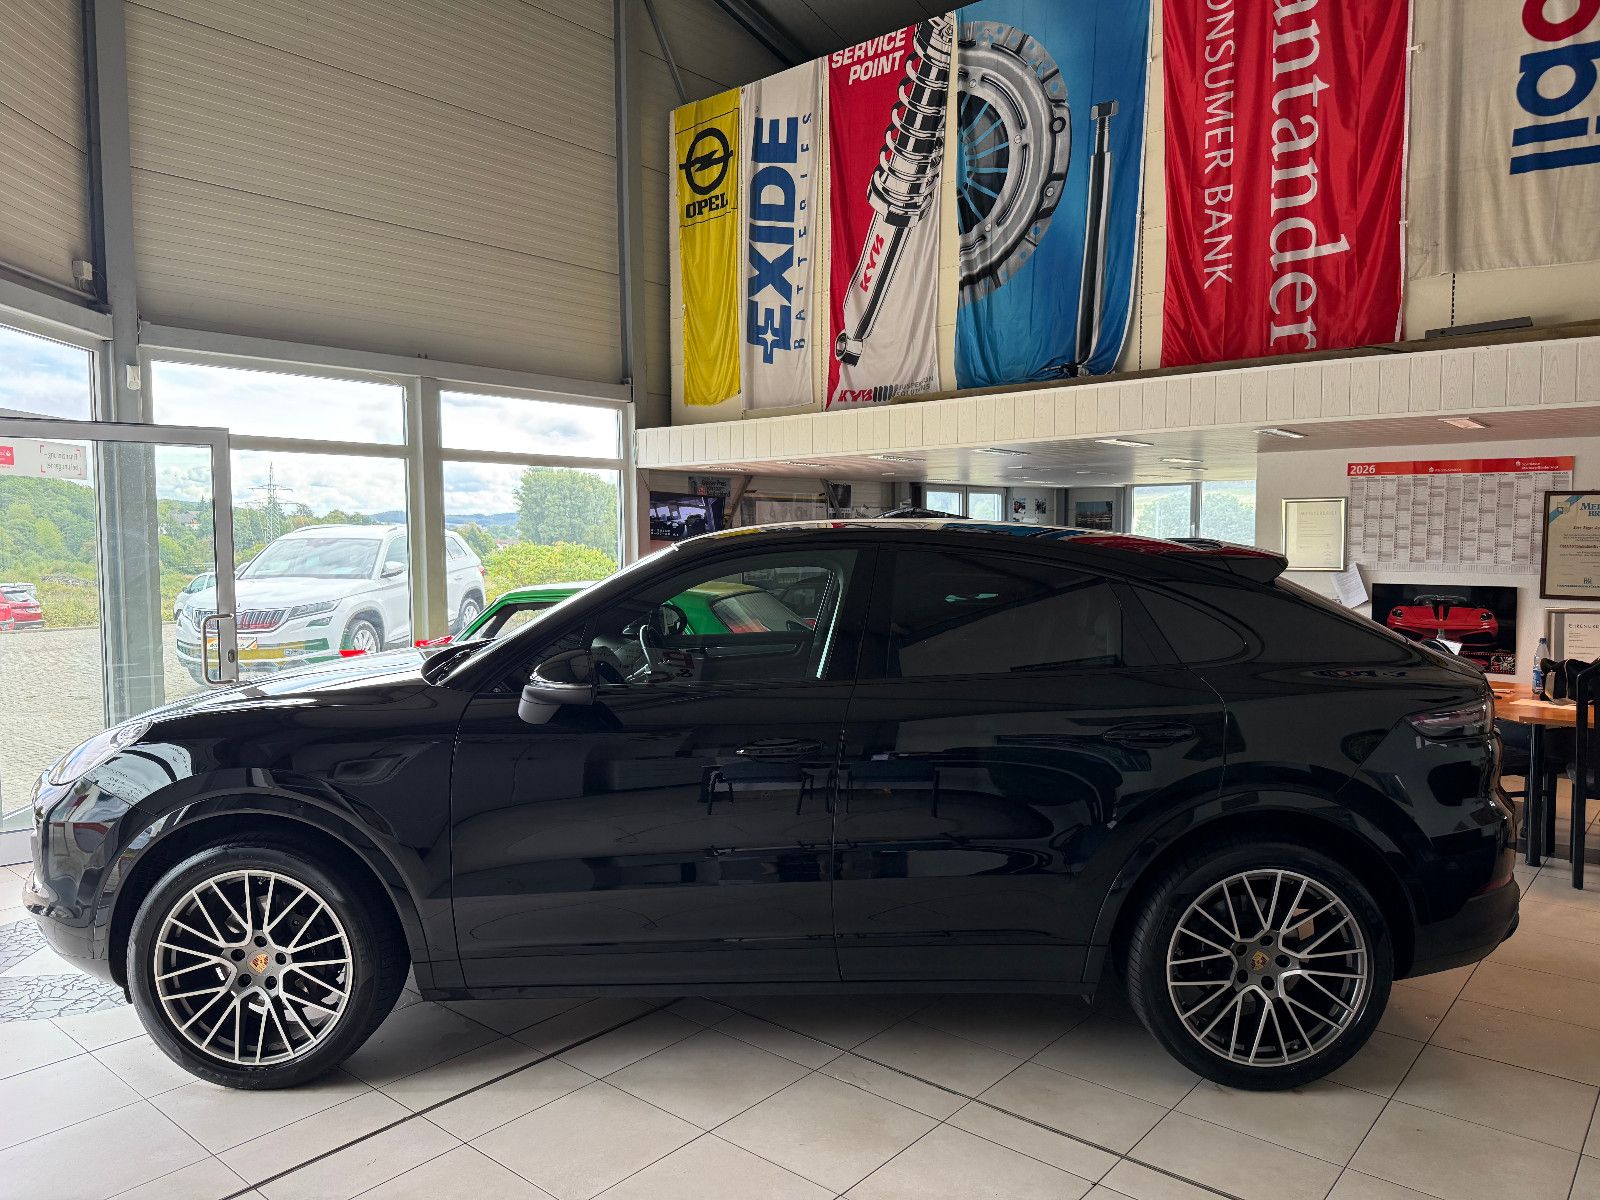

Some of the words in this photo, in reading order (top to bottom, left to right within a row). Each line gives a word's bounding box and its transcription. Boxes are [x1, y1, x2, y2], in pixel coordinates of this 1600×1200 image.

[831, 27, 908, 69] SERVICE
[848, 50, 905, 86] POINT
[1204, 0, 1235, 174] NSUMER
[1509, 0, 1600, 175] obil
[1269, 0, 1351, 350] antander
[685, 192, 729, 219] OPEL
[747, 116, 799, 364] EXIDE
[860, 233, 885, 293] KYB
[1203, 184, 1234, 290] BANK
[838, 388, 874, 402] KYB
[1350, 464, 1376, 475] 2026
